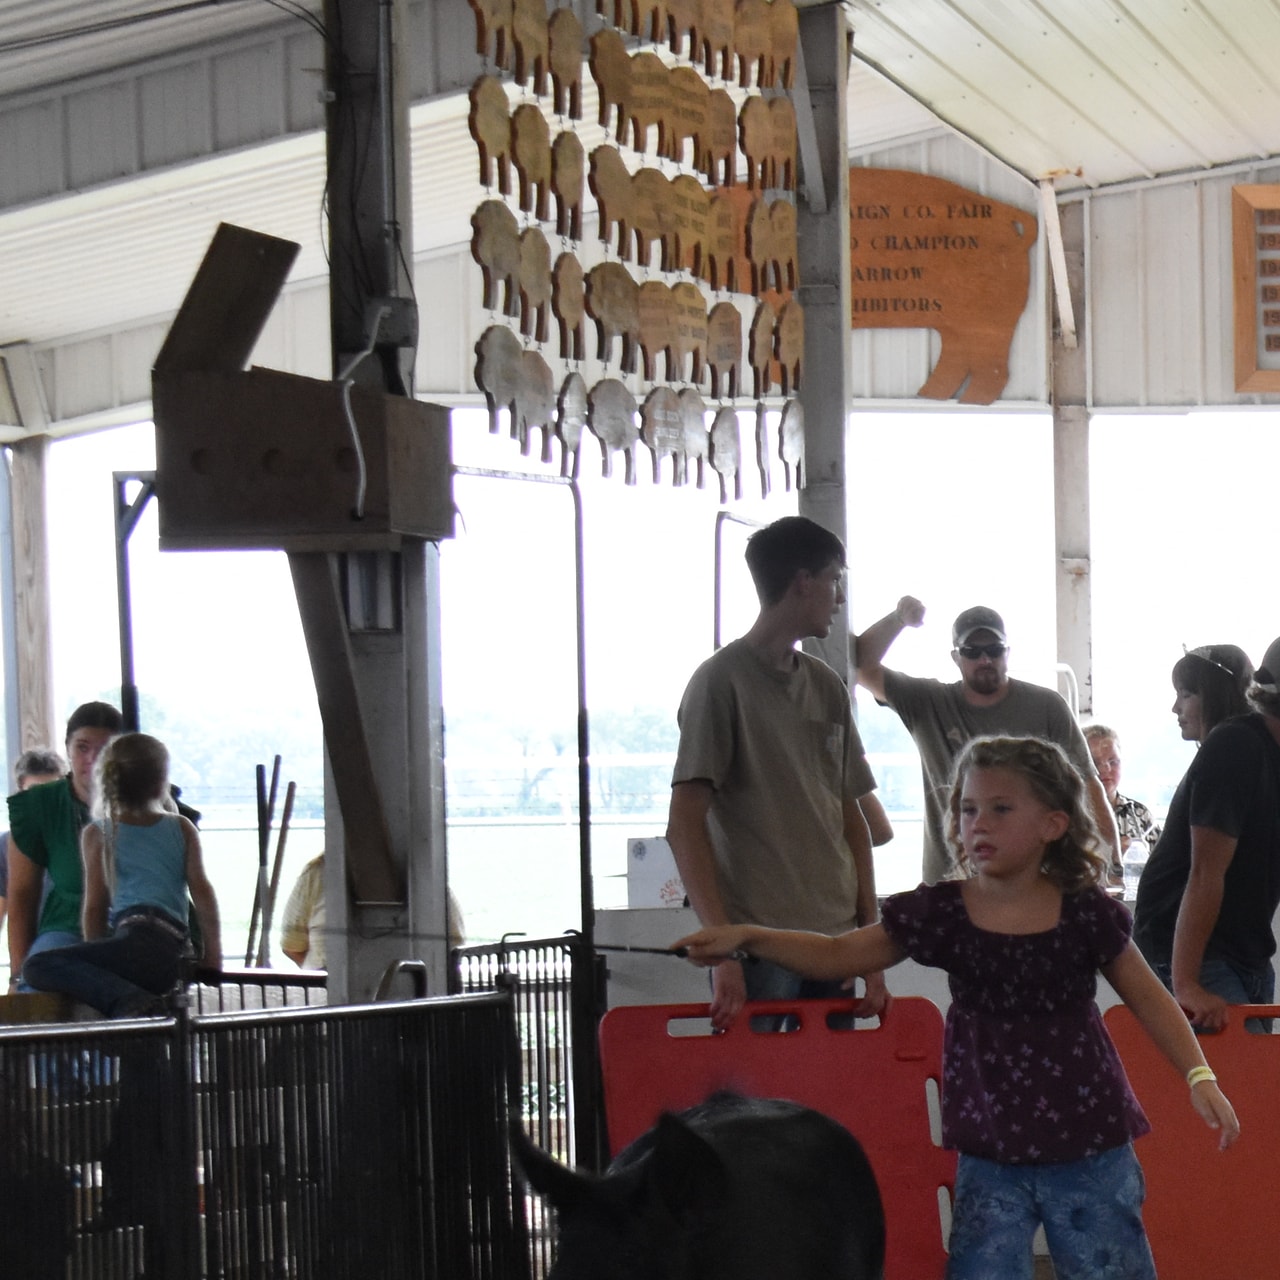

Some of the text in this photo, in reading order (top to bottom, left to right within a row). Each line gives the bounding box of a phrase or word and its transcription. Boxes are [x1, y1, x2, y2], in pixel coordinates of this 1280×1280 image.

[947, 204, 992, 218] FAIR
[872, 235, 979, 250] CHAMPION
[854, 267, 924, 281] ARROW
